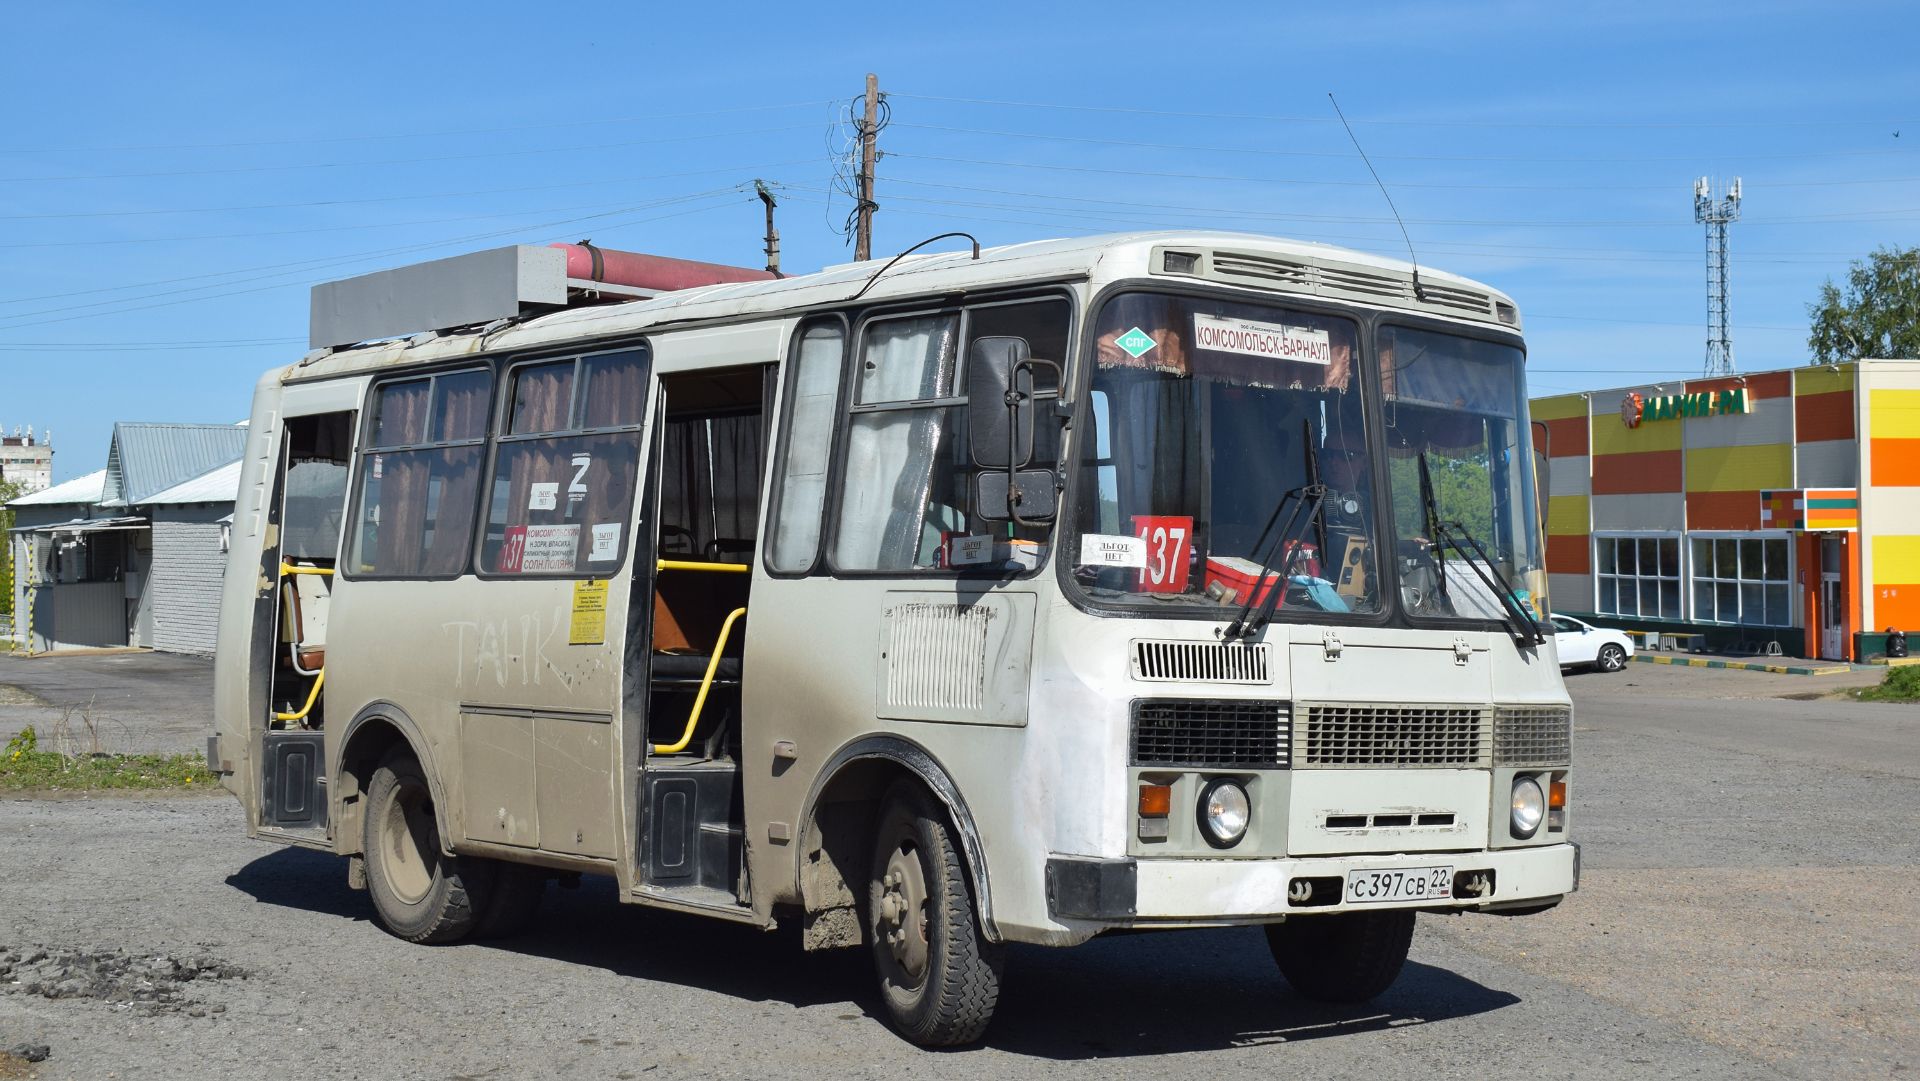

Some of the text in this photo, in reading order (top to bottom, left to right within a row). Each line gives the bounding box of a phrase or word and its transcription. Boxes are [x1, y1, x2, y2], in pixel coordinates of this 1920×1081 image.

[1125, 337, 1146, 348] СПГ
[1197, 326, 1329, 361] КОМСОМОЛЬСК-БАРНАУЛ
[1641, 387, 1745, 422] МАРИЯ-РА
[567, 456, 591, 493] Z
[526, 526, 580, 538] КОМСОМОЛЬСКИЙ
[501, 534, 525, 570] 137
[963, 540, 982, 550] ЛЬГОТ
[1100, 542, 1129, 551] ЛЬГОТ
[965, 550, 978, 559] НЕТ
[1105, 552, 1124, 561] НЕТ
[441, 606, 574, 695] ТАНК
[1430, 869, 1447, 888] 22
